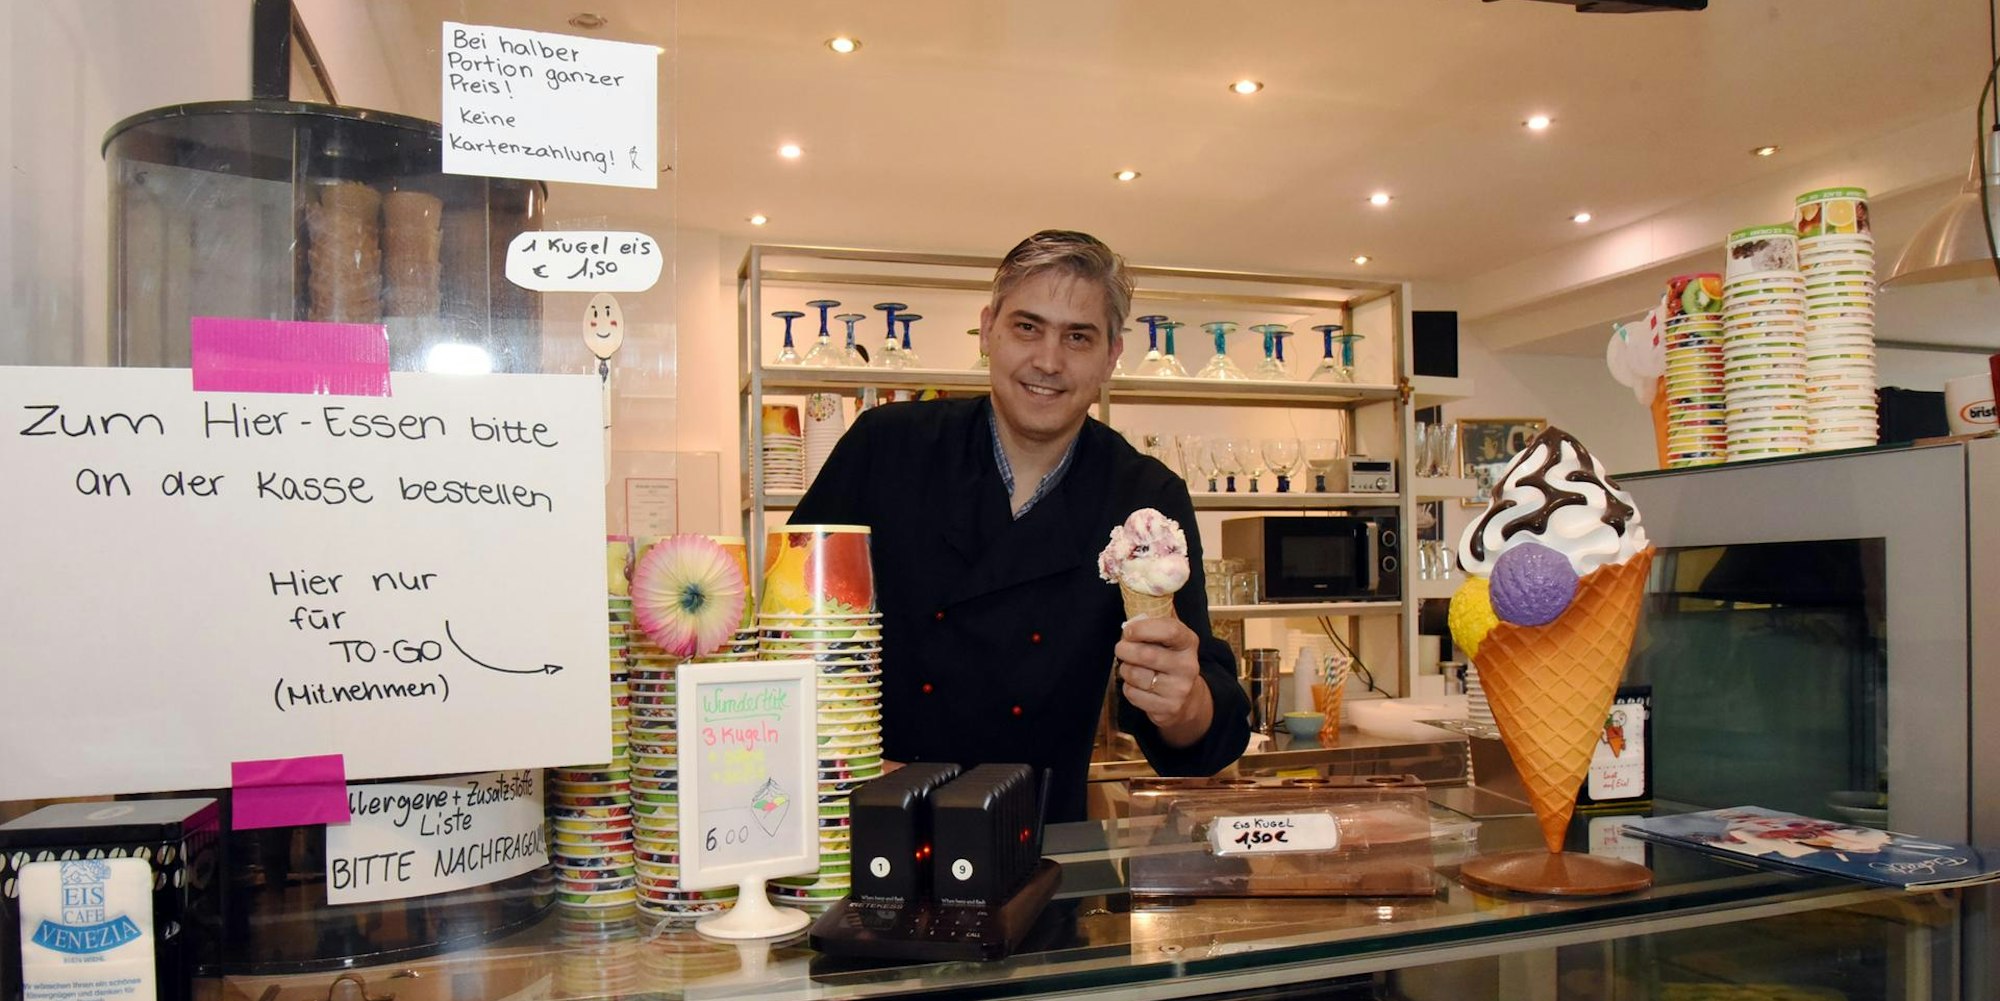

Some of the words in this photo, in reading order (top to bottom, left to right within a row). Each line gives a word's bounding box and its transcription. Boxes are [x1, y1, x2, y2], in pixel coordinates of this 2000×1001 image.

[453, 29, 487, 50] Bei
[499, 36, 579, 62] halber
[448, 52, 533, 78] Portion
[545, 68, 624, 90] ganzer
[450, 73, 514, 100] Preis!
[449, 133, 615, 173] Kartenzahlung!
[522, 239, 537, 254] 1
[620, 238, 650, 255] eis
[532, 264, 549, 278] €
[567, 258, 618, 280] 1,50
[20, 404, 165, 437] Zum
[470, 417, 558, 448] bitte
[76, 467, 131, 497] an
[161, 469, 225, 497] der
[256, 471, 373, 505] Kasse
[399, 476, 553, 513] bestellen
[269, 570, 343, 597] Hier
[372, 569, 438, 591] nur
[289, 606, 347, 631] für
[329, 639, 442, 663] TO-GO
[702, 727, 717, 746] 3
[722, 721, 779, 752] Kugeln
[350, 790, 447, 828] llergene
[467, 769, 533, 807] Zusatzstoffe
[420, 806, 472, 836] Liste
[1235, 831, 1288, 849] 1,50€
[332, 850, 416, 889] BITTE
[959, 865, 966, 874] 9
[64, 887, 104, 906] EIS
[64, 908, 104, 924] CAFE
[42, 921, 138, 949] VENEZIA
